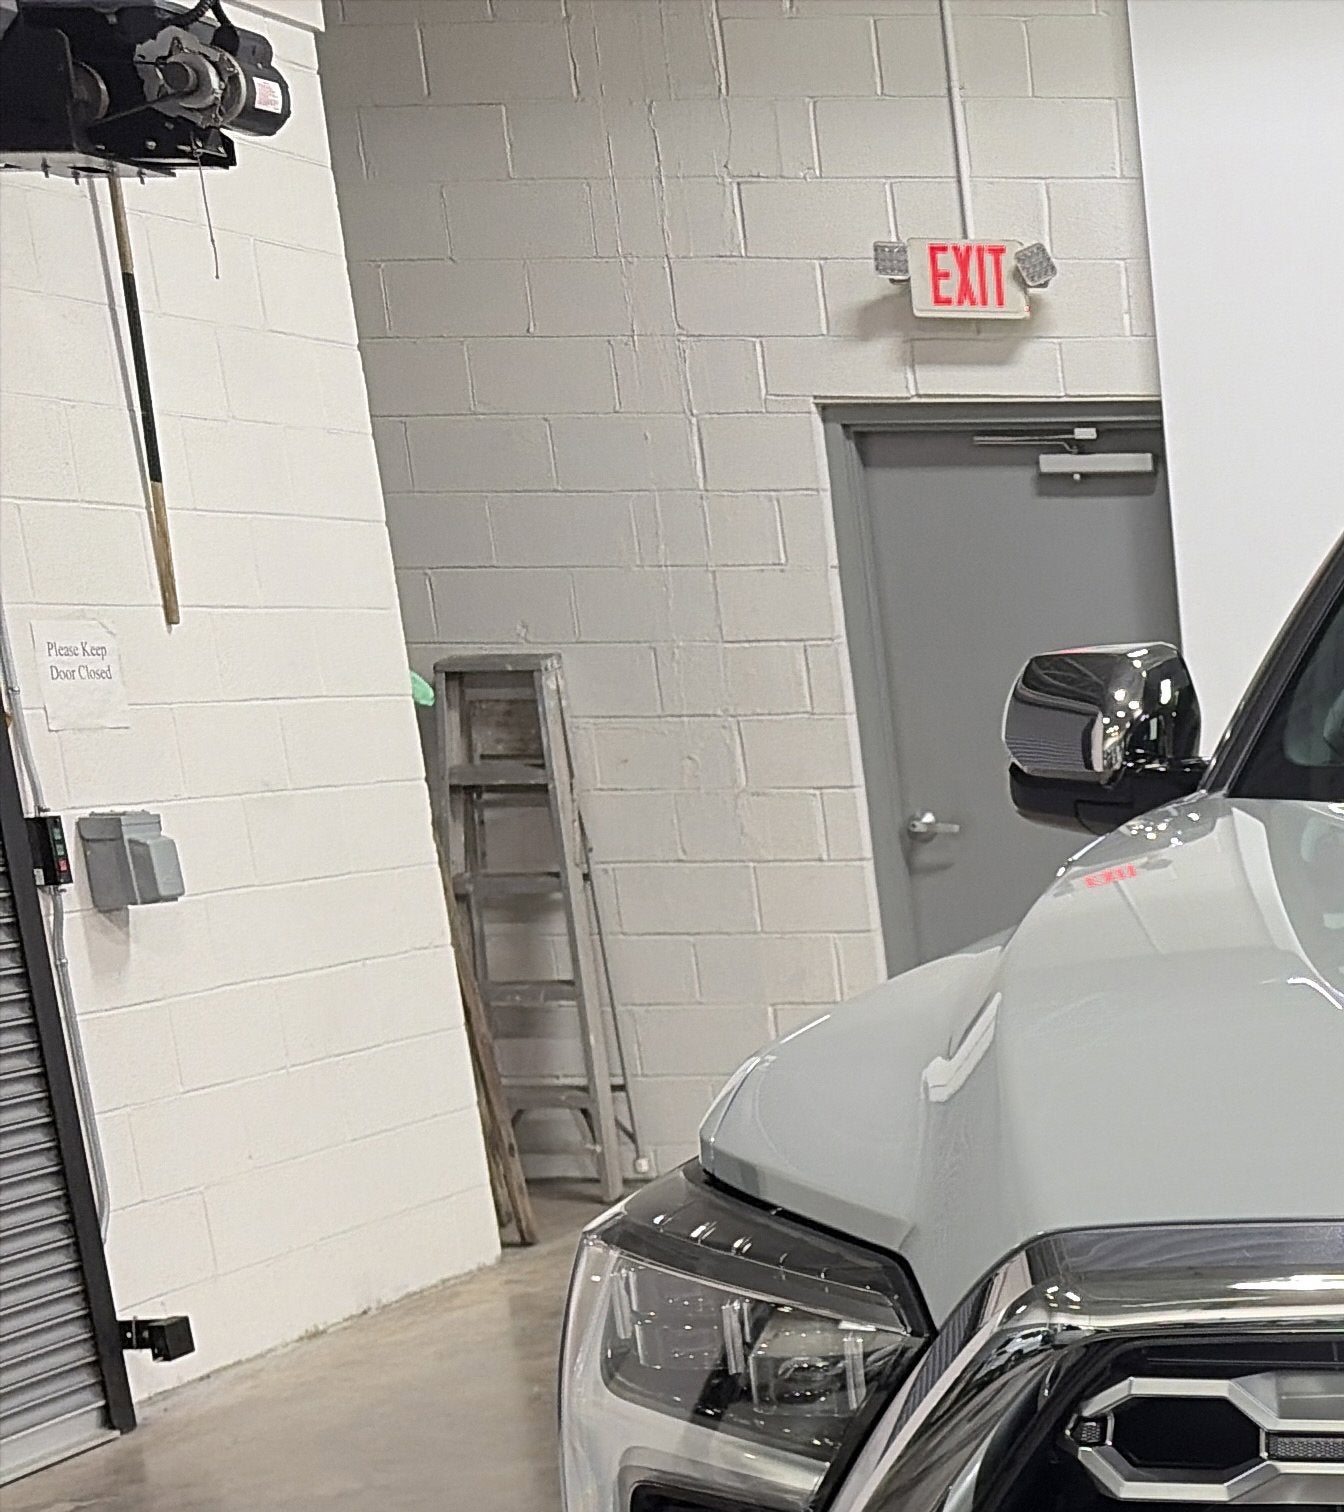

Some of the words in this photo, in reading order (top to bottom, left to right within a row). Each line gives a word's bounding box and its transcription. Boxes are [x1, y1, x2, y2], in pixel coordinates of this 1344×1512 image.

[927, 243, 1006, 307] EXIT
[47, 641, 79, 657] Please
[80, 641, 107, 660] Keep
[50, 665, 76, 680] Door
[78, 665, 112, 680] Closed
